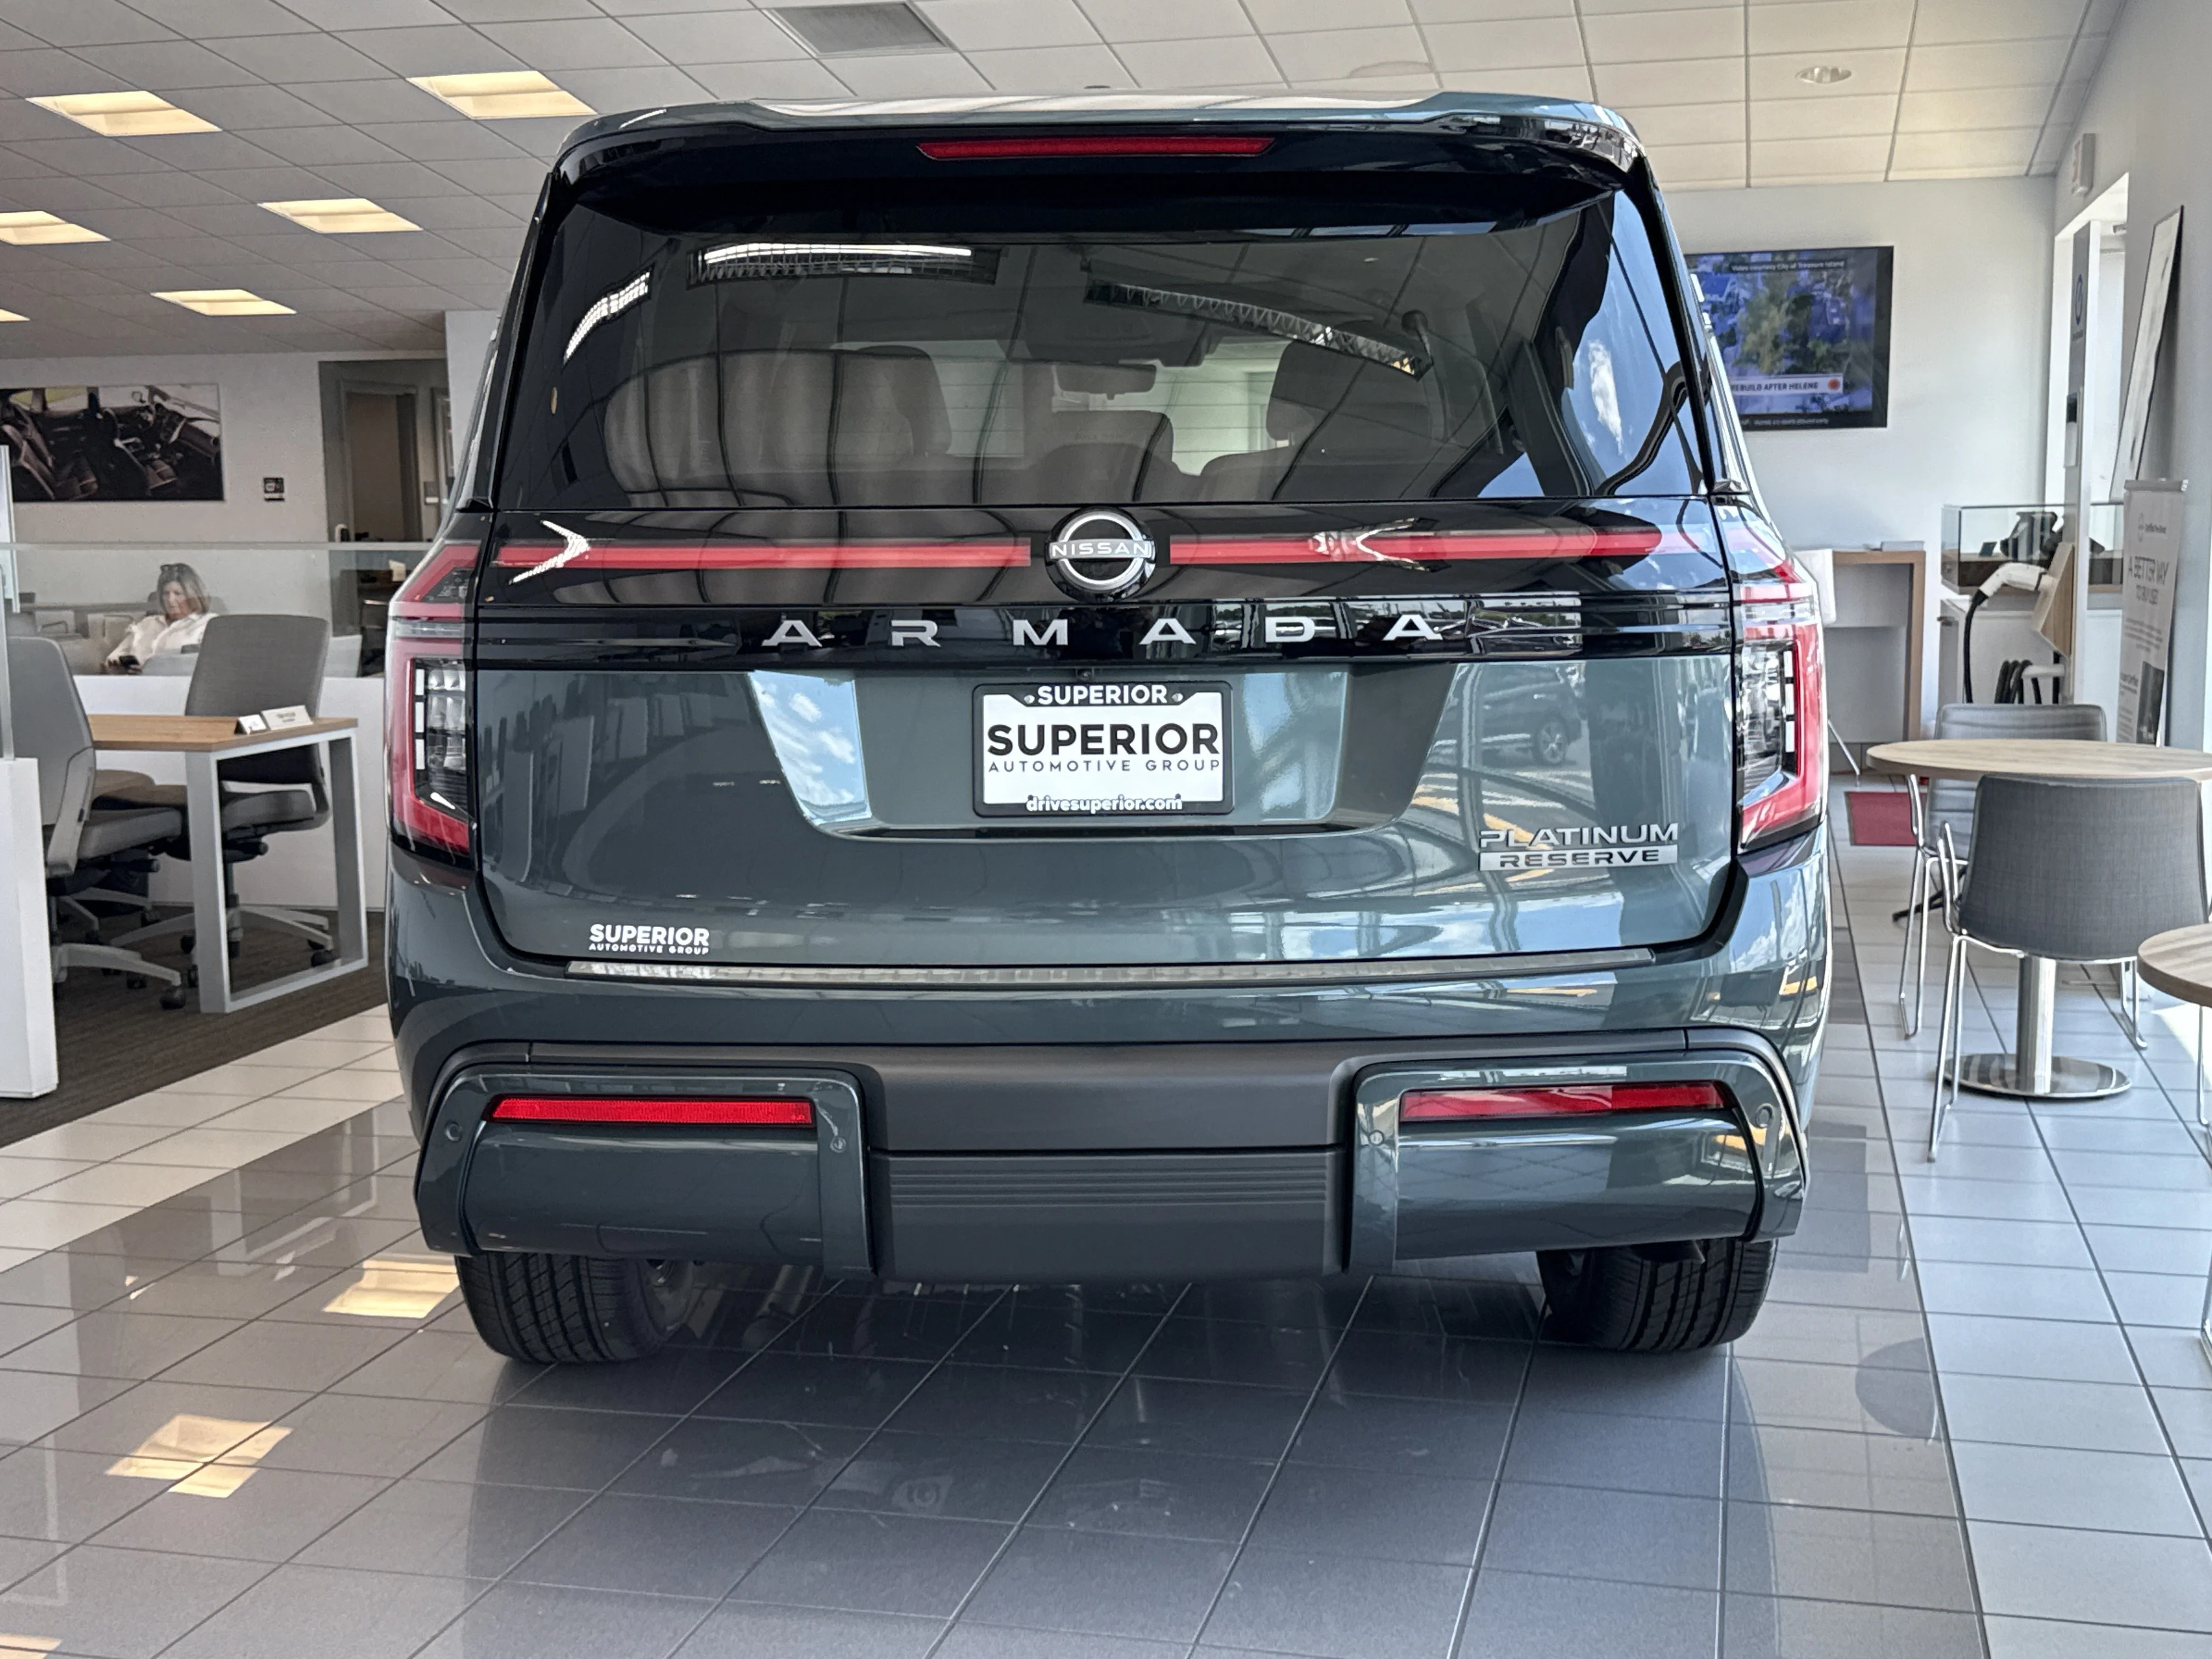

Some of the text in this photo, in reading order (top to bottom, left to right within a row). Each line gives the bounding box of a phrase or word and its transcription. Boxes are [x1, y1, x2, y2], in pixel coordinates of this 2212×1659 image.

[1052, 542, 1148, 557] NISSAN
[762, 615, 1443, 647] ARMADA
[1037, 685, 1168, 705] SUPERIOR
[988, 723, 1220, 756] SUPERIOR
[988, 759, 1220, 772] AUTOMOTIVE GROUP
[1026, 794, 1183, 814] drivesuperior.com
[1480, 823, 1678, 848] PLATINUM
[1500, 849, 1660, 868] RESERVE
[589, 923, 709, 946] SUPERIOR
[589, 943, 709, 955] AUTOMOTIVE GROUP
